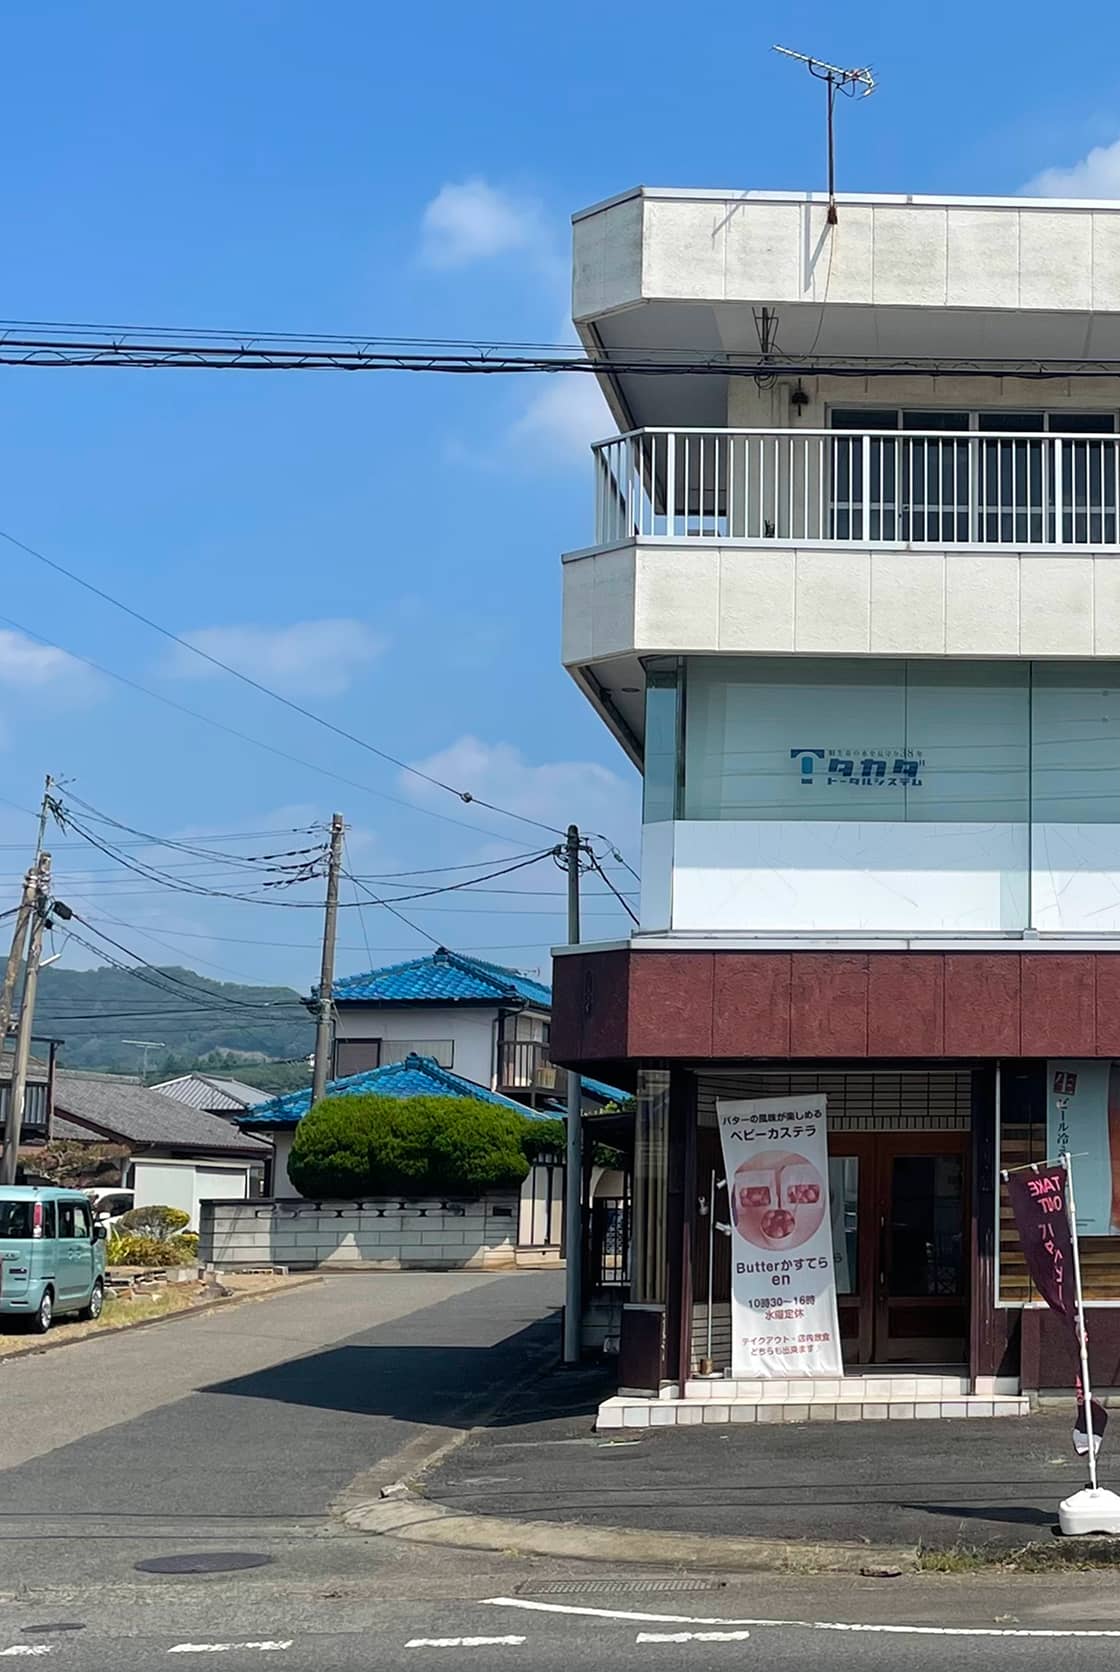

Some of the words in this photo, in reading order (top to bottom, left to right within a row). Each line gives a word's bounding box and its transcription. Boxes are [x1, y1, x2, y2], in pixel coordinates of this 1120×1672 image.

[827, 777, 923, 786] トータルシステム
[723, 1109, 822, 1125] バターの風味が楽しめる
[730, 1125, 816, 1141] ベビーカステラ
[736, 1257, 829, 1274] Butterかすてら
[771, 1274, 791, 1286] en
